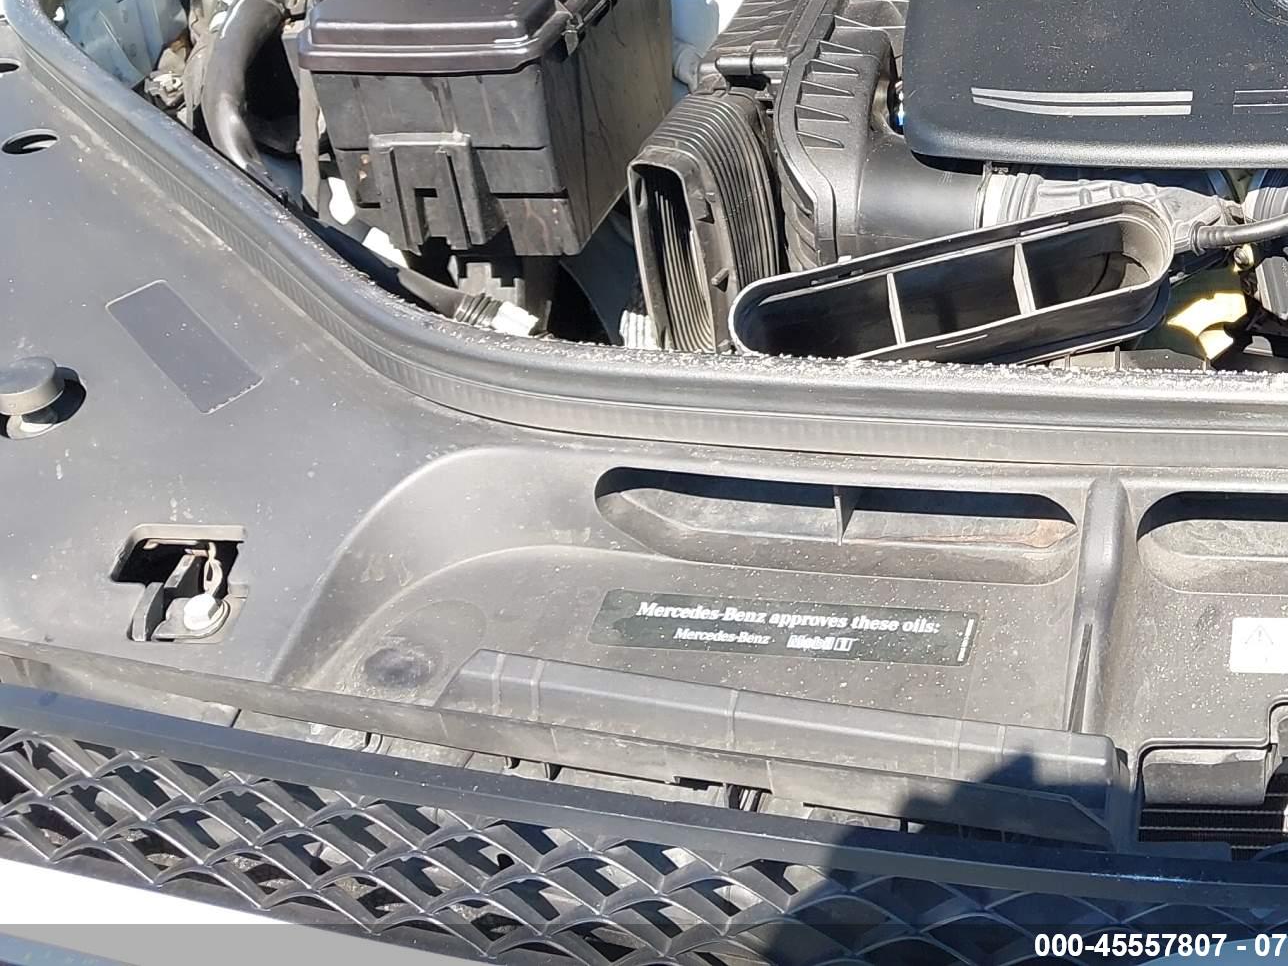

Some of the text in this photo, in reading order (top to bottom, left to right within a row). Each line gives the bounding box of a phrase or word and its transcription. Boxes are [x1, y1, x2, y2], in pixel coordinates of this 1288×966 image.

[636, 601, 942, 634] Mercedes-Benz approves these oils:
[673, 627, 771, 645] Mercedes-Benz
